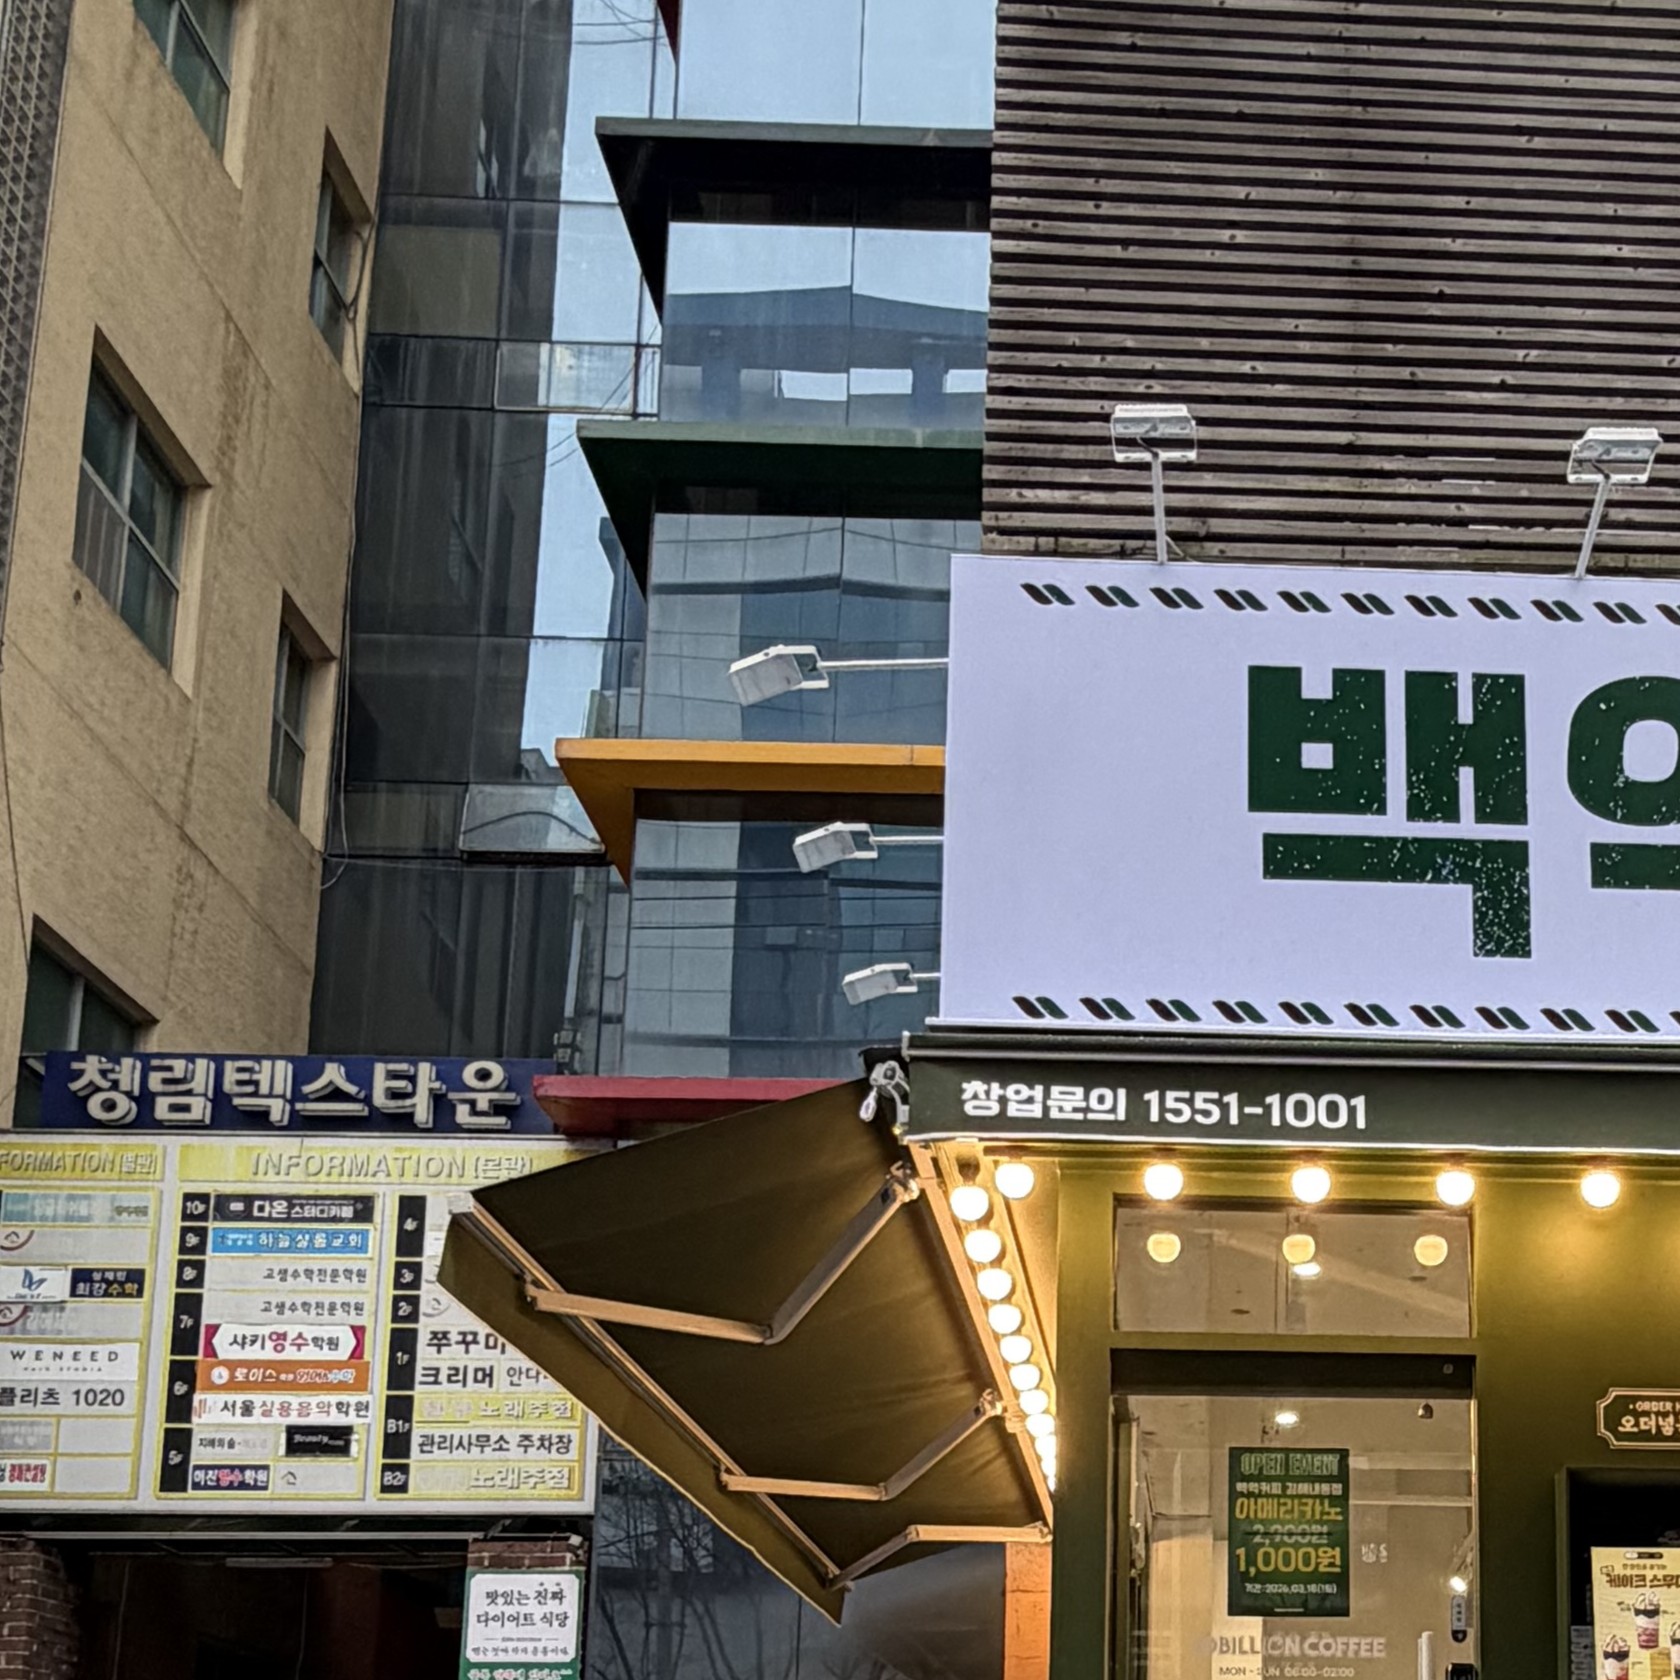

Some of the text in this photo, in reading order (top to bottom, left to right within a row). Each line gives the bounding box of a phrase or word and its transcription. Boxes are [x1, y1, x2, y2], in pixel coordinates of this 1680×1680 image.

[68, 1055, 521, 1129] 청림텍스타운
[961, 1080, 1366, 1129] 창업문의 1551-1001
[252, 1153, 466, 1178] INFORMATION
[253, 1200, 354, 1218] 다온 스터디카페
[229, 1331, 340, 1353] 샤키영수학원
[11, 1350, 118, 1362] WENEED
[418, 1365, 494, 1388] 크리머
[72, 1389, 125, 1406] 1020
[220, 1400, 370, 1419] 서울실용음악학원
[418, 1434, 573, 1454] 관리사무소 주차장
[1241, 1453, 1340, 1476] OPEN EVENT
[1235, 1497, 1343, 1521] 아메리카노
[1235, 1547, 1342, 1577] 1,000원
[486, 1587, 566, 1606] 맛있는 진짜
[476, 1611, 569, 1628] 다이어트 식당
[1304, 1635, 1386, 1658] COFFEE
[1219, 1667, 1246, 1677] MON
